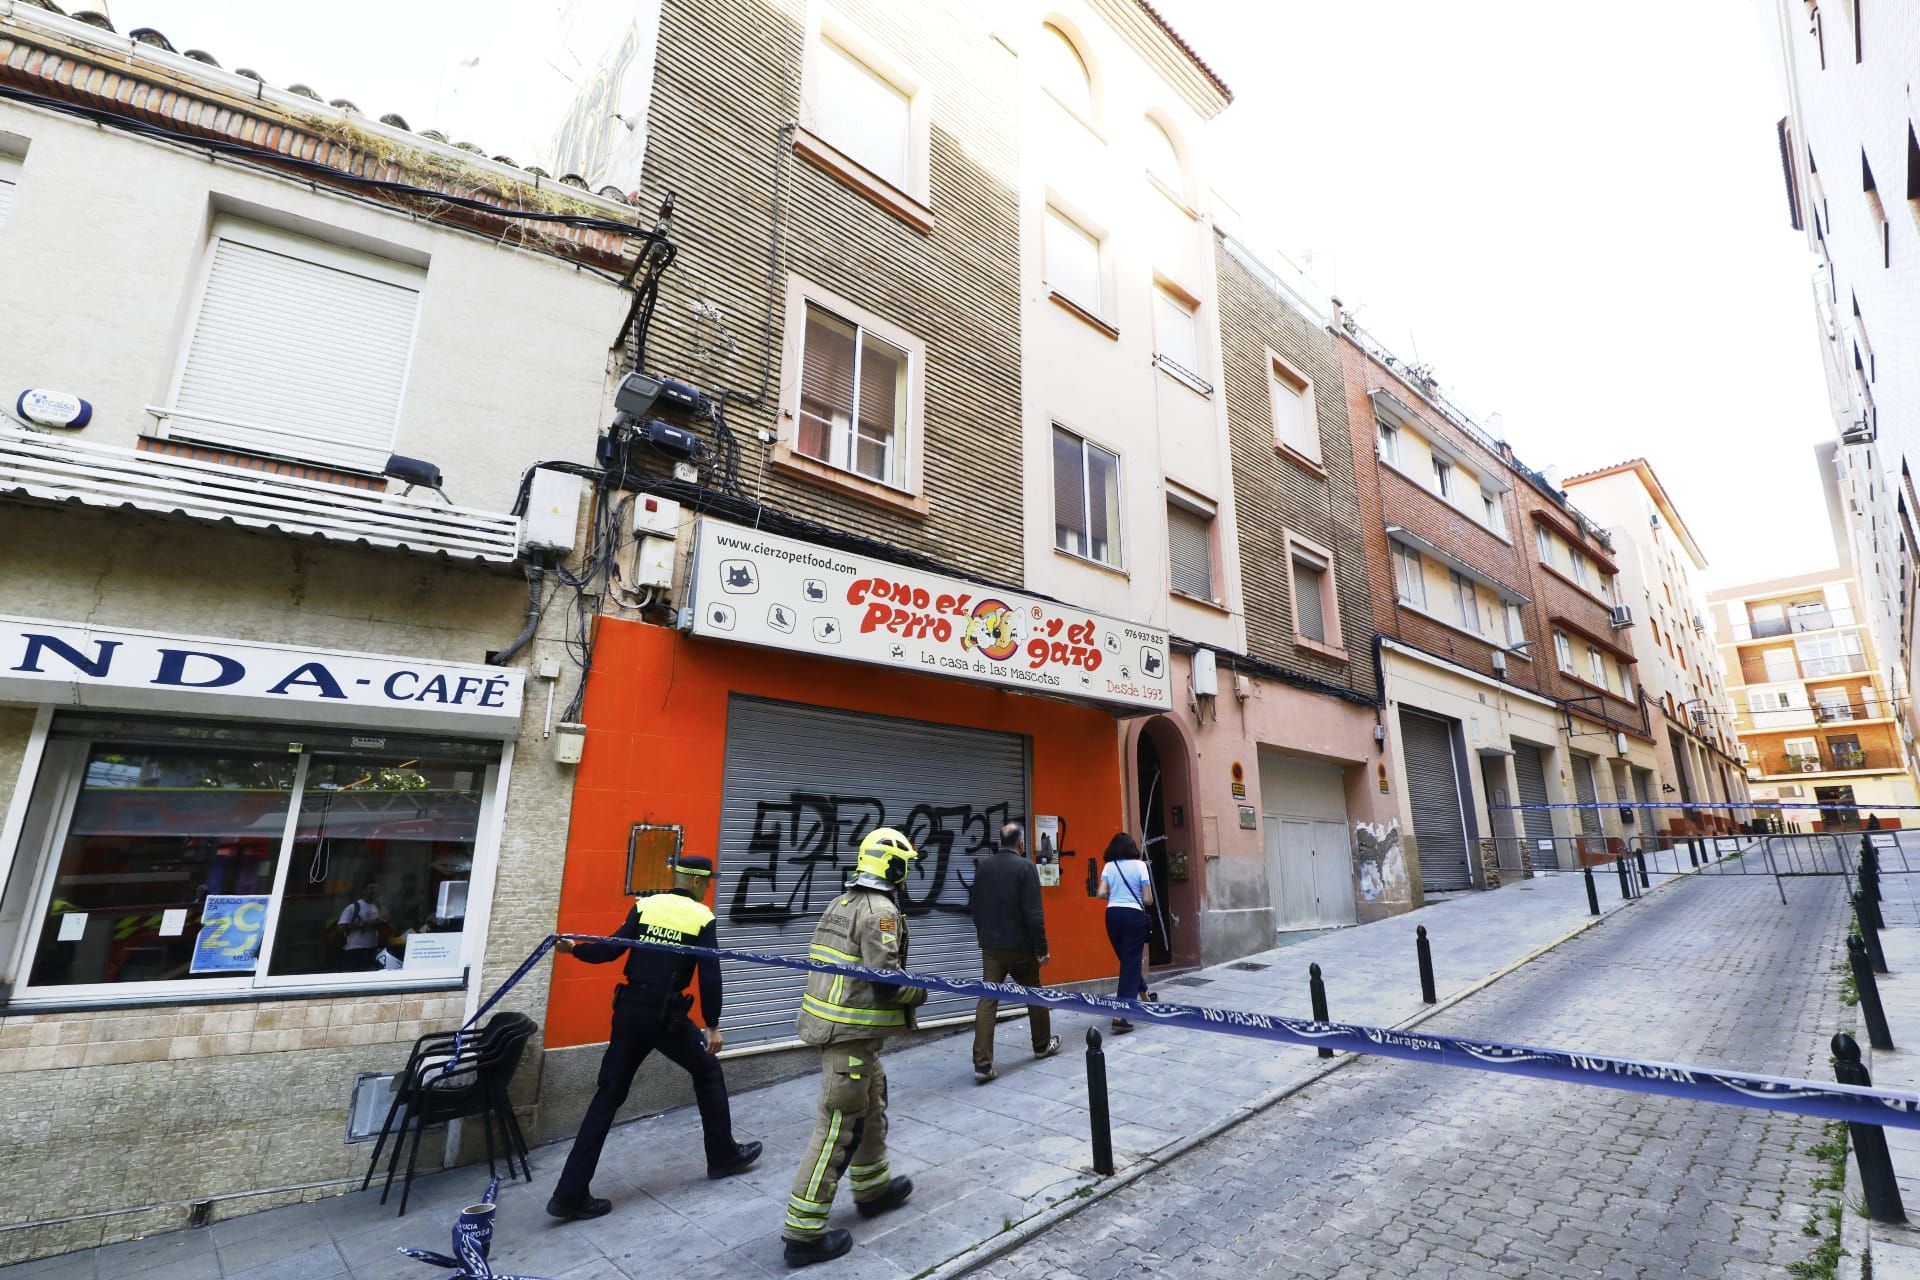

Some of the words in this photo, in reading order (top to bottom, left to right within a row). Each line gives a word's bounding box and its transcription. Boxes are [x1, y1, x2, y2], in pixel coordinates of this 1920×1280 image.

[717, 535, 857, 575] www.cierzopetfood.com
[921, 651, 936, 664] La
[940, 656, 969, 670] casa
[972, 660, 986, 674] de
[990, 662, 1007, 677] las
[1143, 685, 1163, 700] 1993
[1096, 996, 1131, 1010] Zaragoza
[1202, 1007, 1224, 1022] NO
[1228, 1012, 1273, 1029] PASAR
[1385, 1033, 1441, 1051] Zaragoza
[1570, 1055, 1608, 1072] NO
